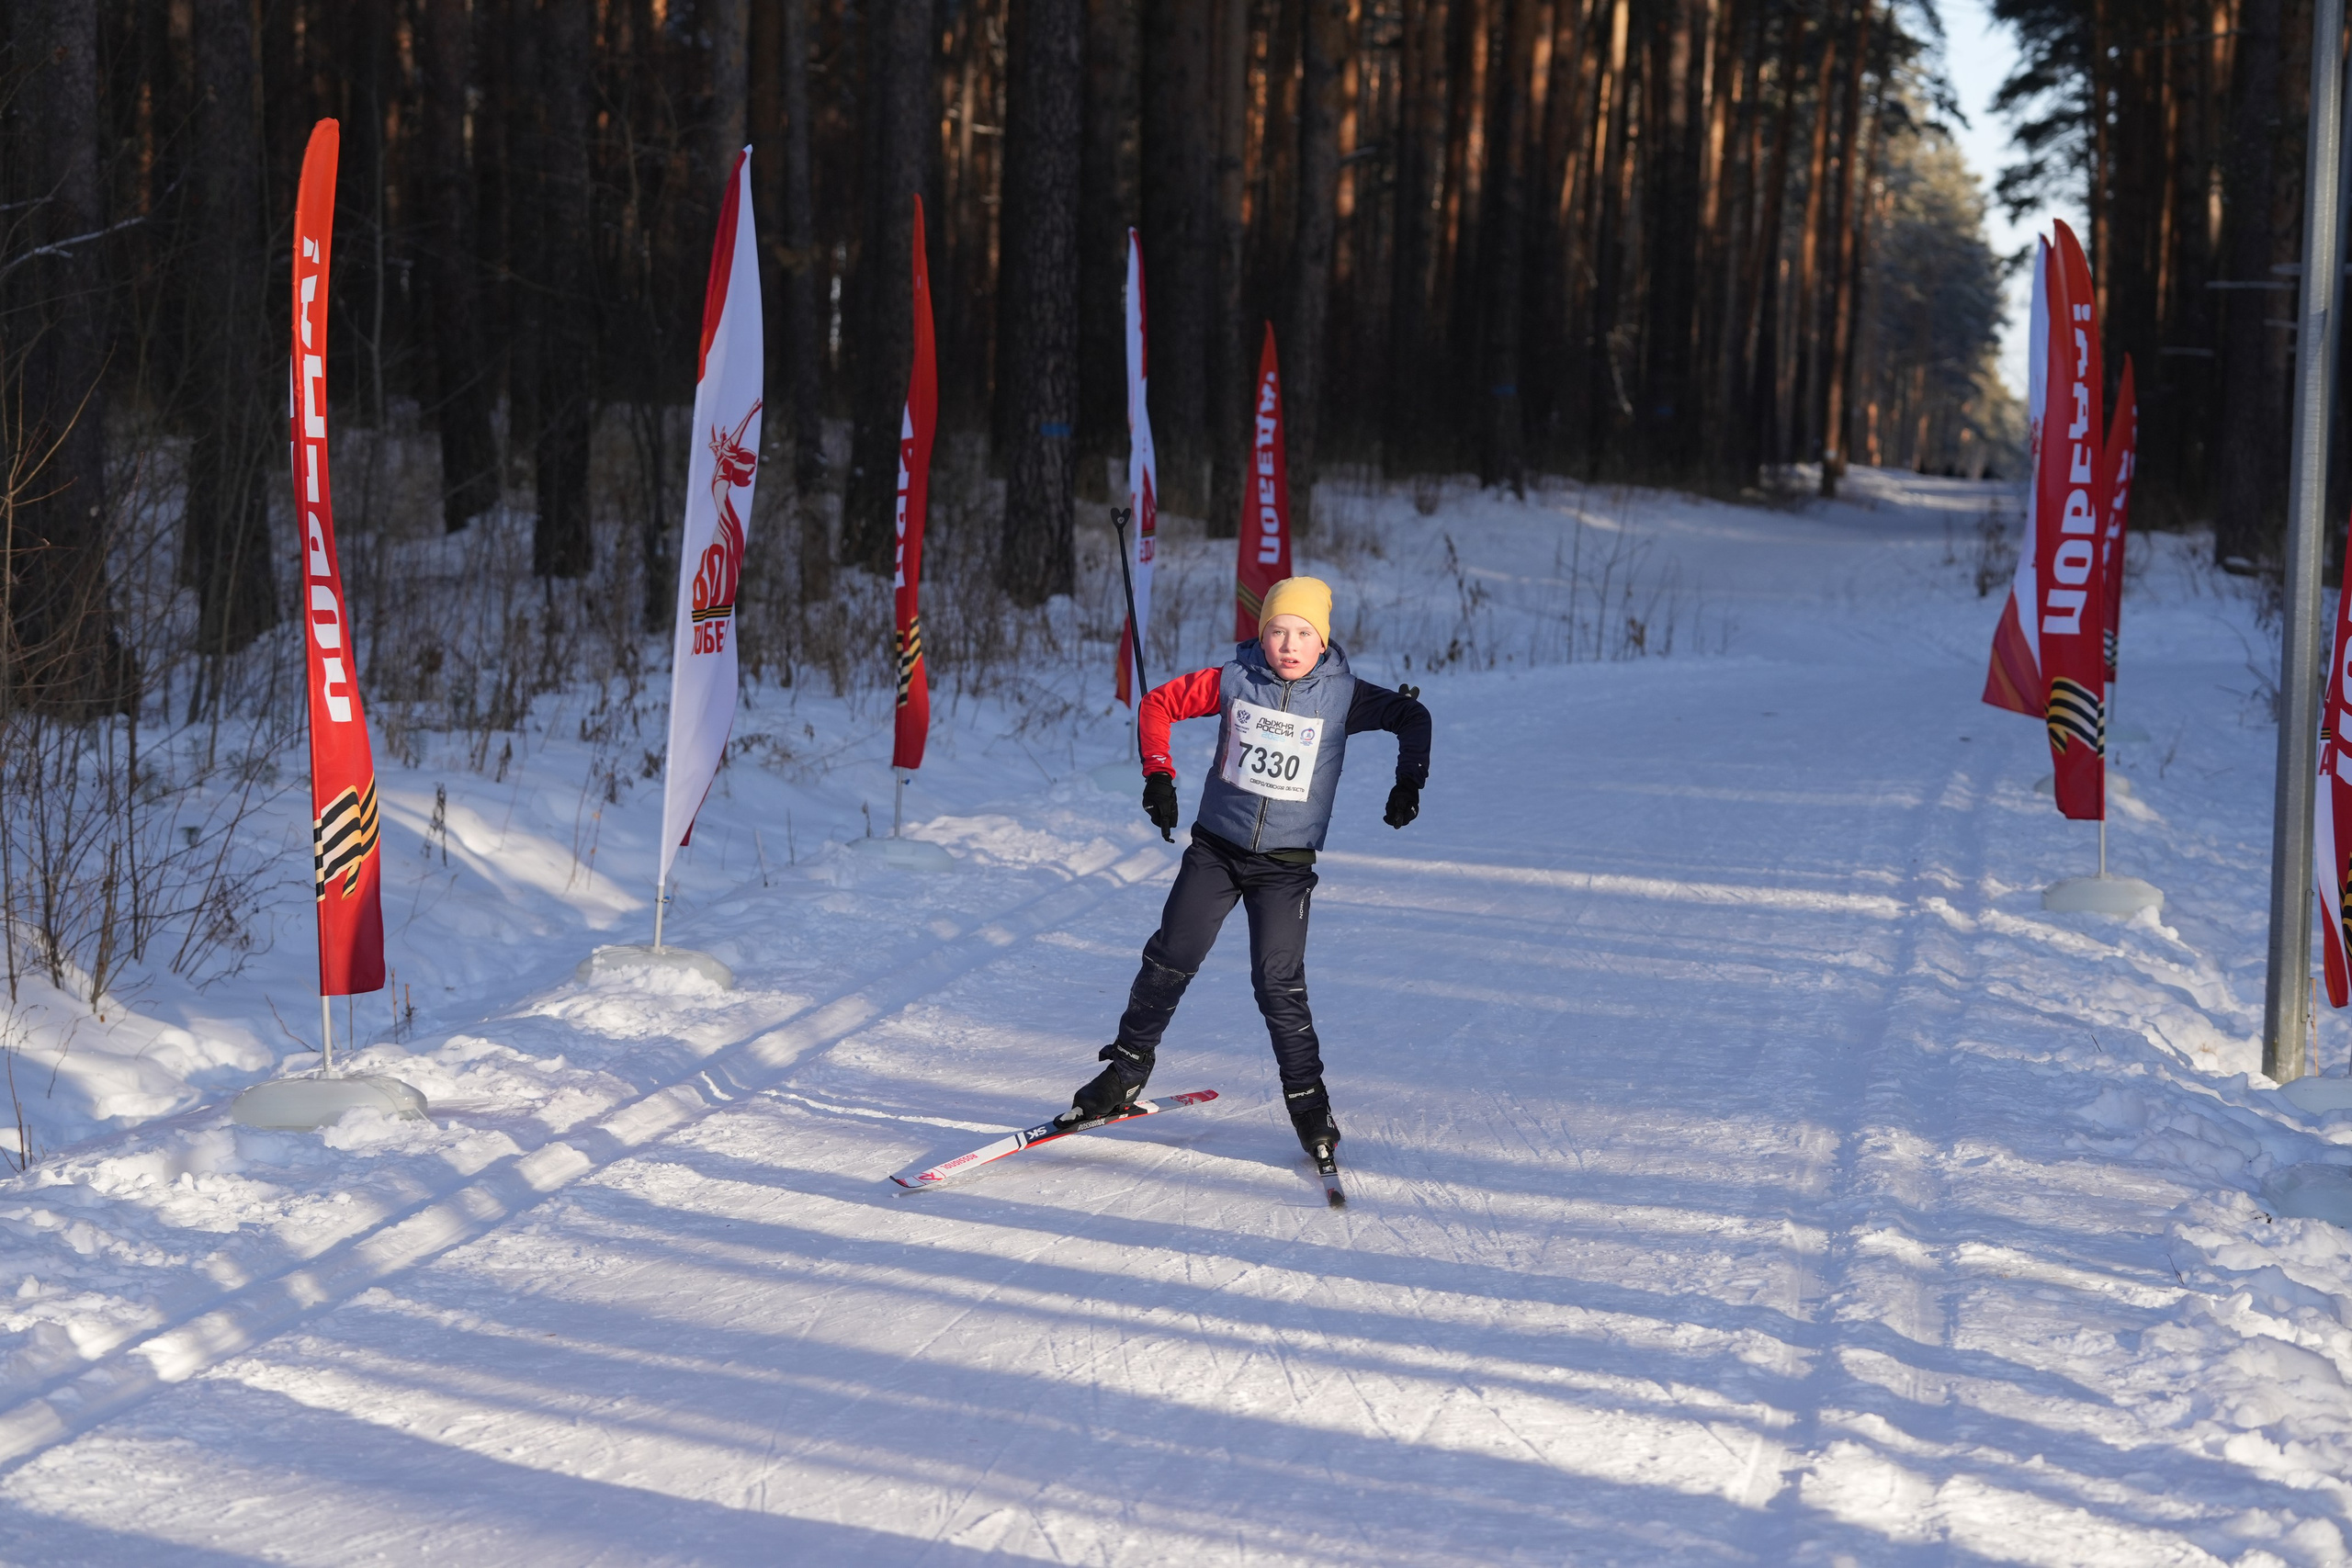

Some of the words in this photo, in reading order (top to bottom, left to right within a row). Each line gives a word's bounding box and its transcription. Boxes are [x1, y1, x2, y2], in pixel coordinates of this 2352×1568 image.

[1256, 723, 1295, 738] РОССИИ
[1259, 716, 1295, 731] ЛЫЖНЯ
[1238, 740, 1300, 782] 7330
[1250, 777, 1284, 791] СВЕРДЛОВСКАЯ
